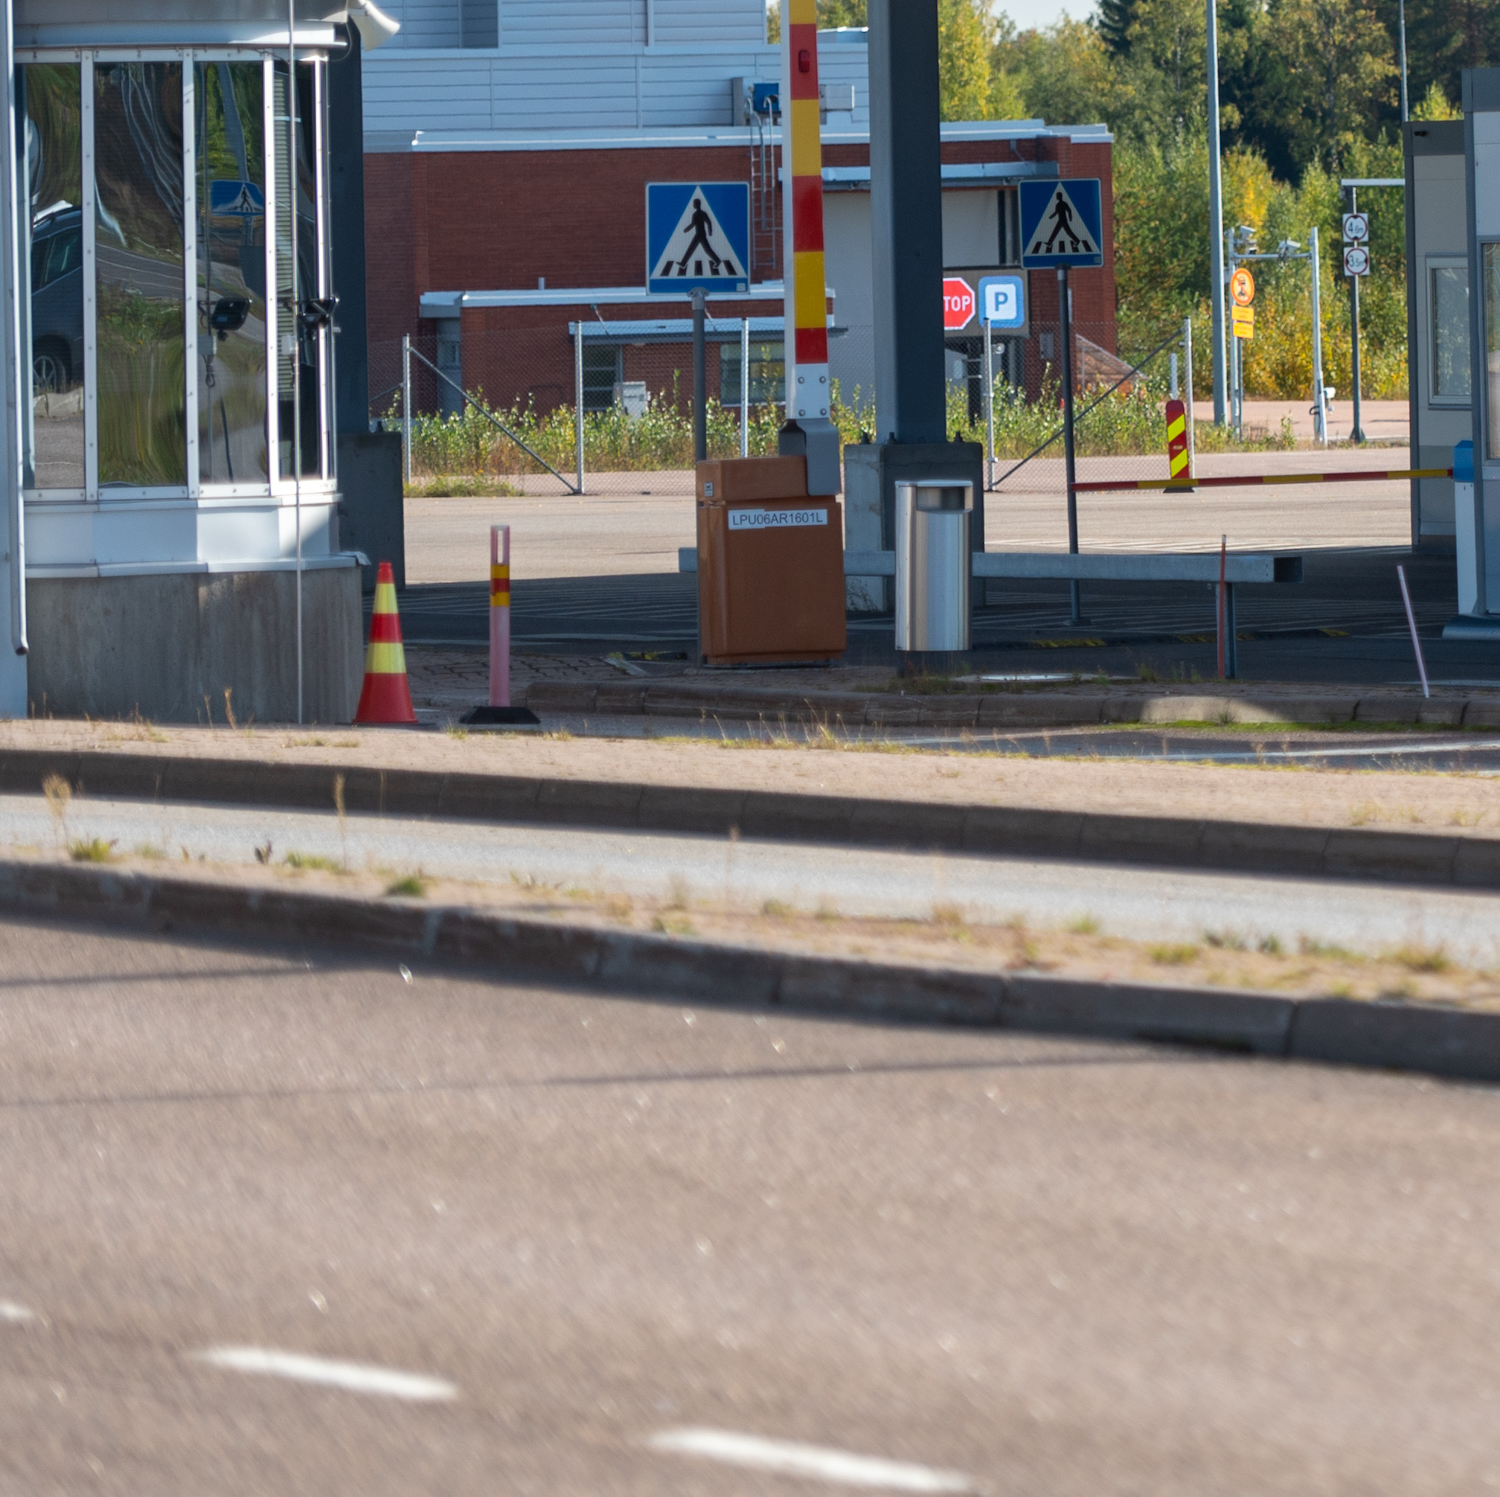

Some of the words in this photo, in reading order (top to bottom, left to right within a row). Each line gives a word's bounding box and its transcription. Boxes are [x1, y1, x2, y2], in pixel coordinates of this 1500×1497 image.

[943, 296, 971, 312] TOP
[994, 292, 1008, 311] P
[732, 512, 823, 526] LPU06AR1601L
